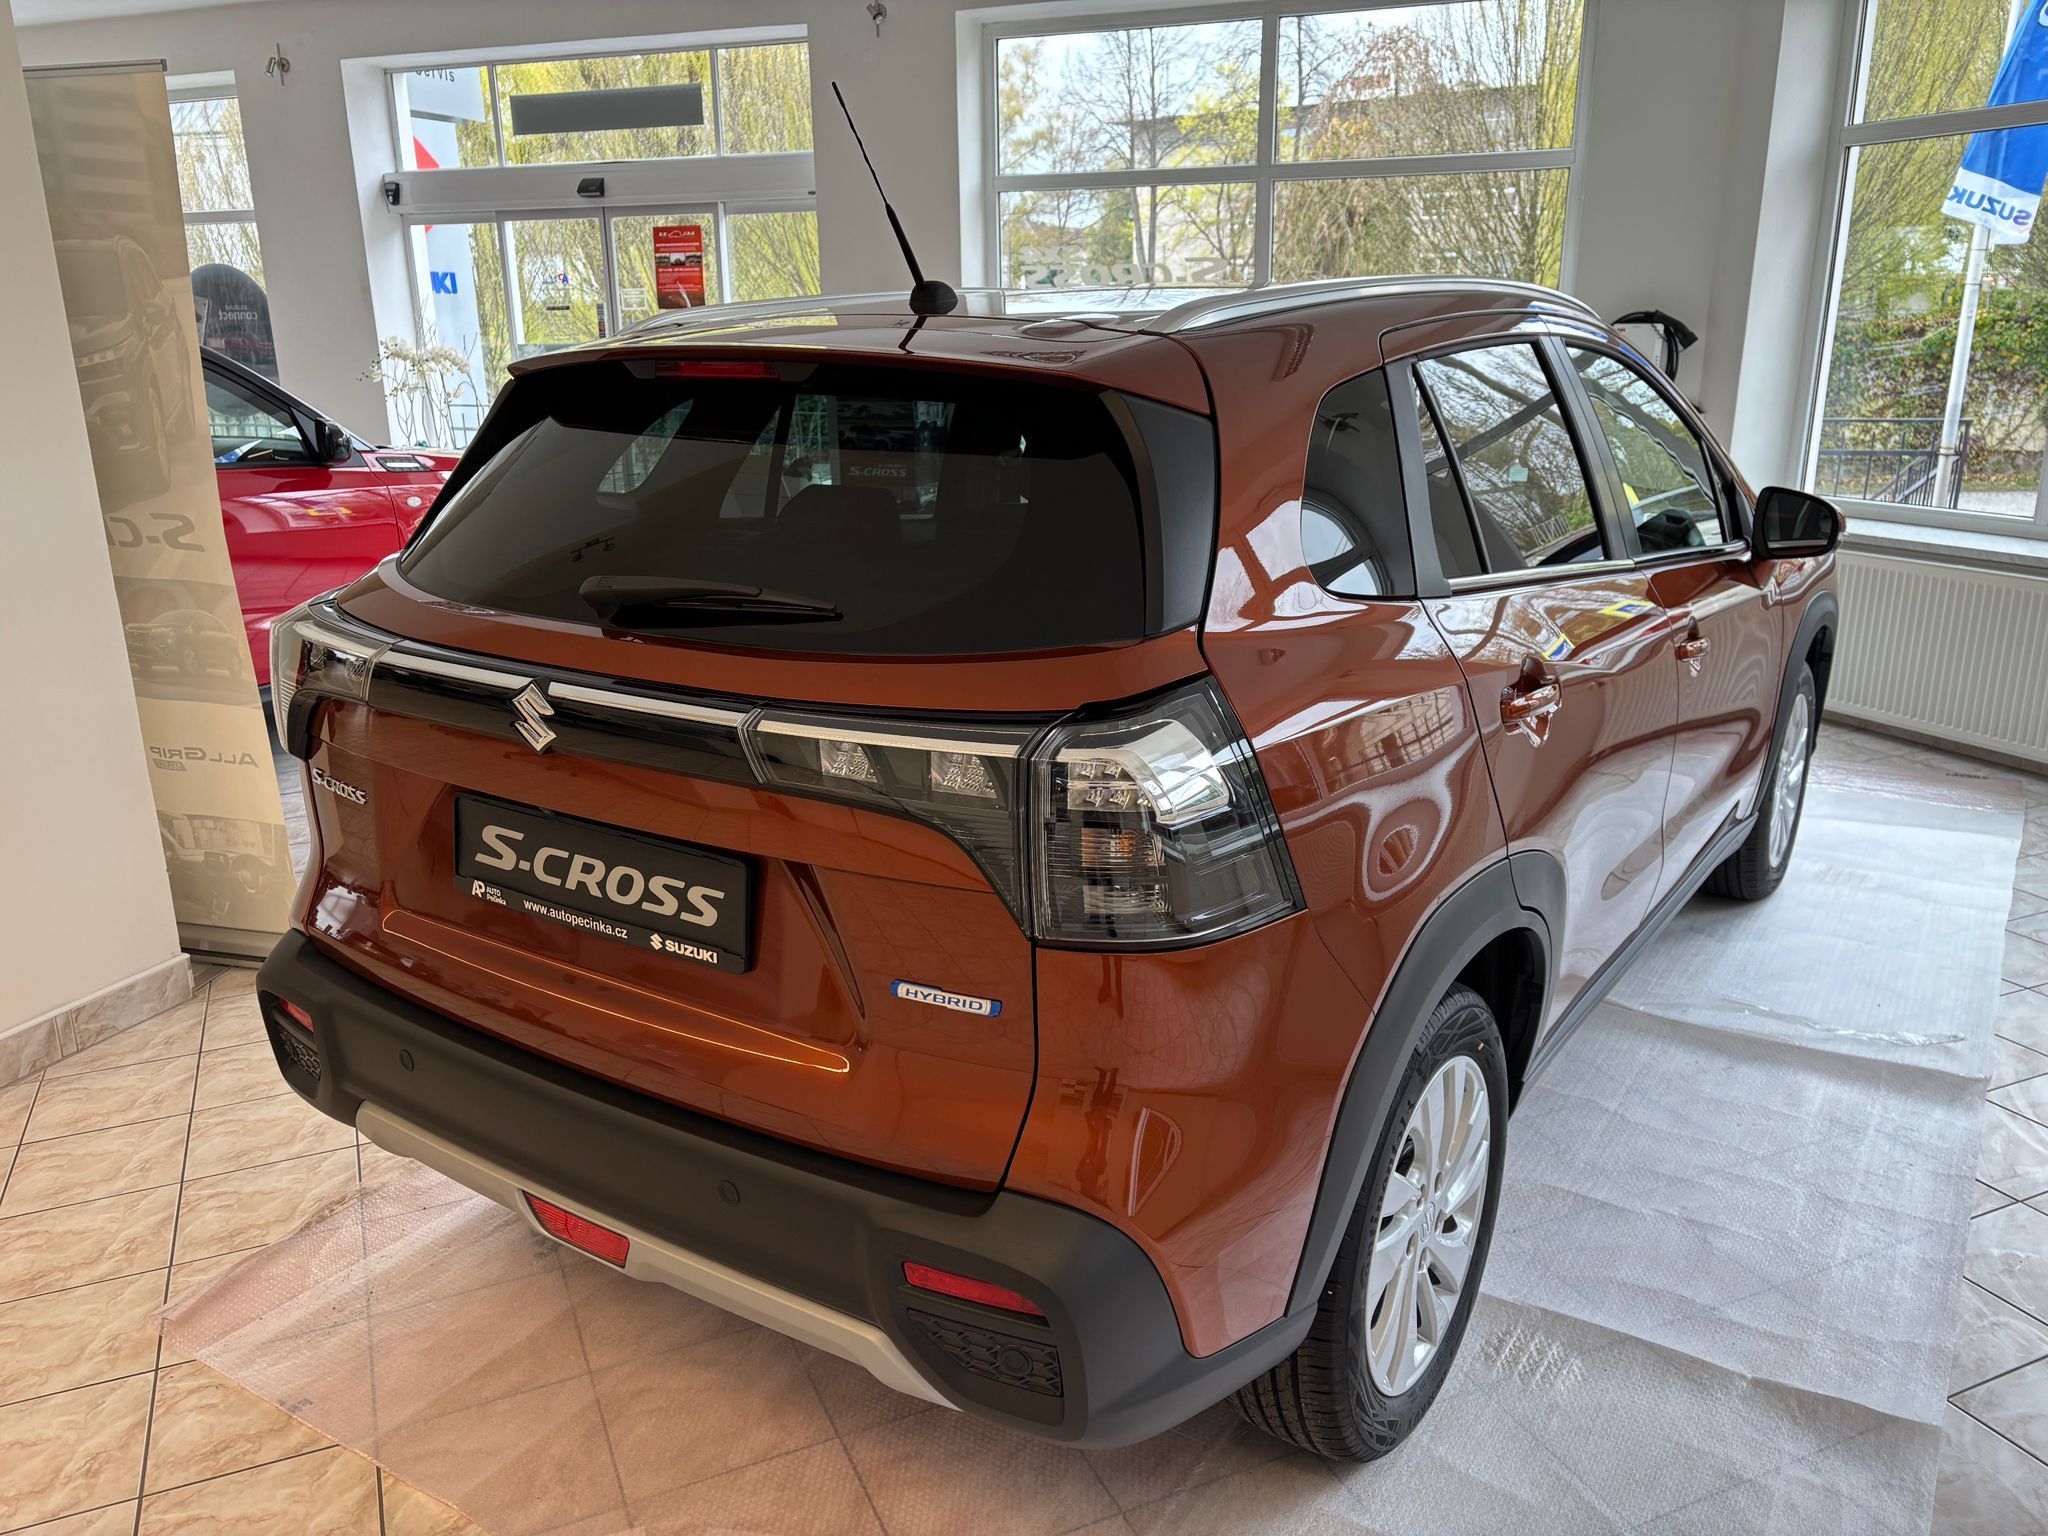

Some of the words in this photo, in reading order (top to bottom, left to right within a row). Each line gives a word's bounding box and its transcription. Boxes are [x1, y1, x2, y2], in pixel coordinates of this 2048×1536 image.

[486, 886, 501, 897] AUTO
[523, 899, 629, 939] www.autopecinka.cz
[664, 939, 718, 964] SUZUKI
[905, 988, 983, 1011] HYBRID
